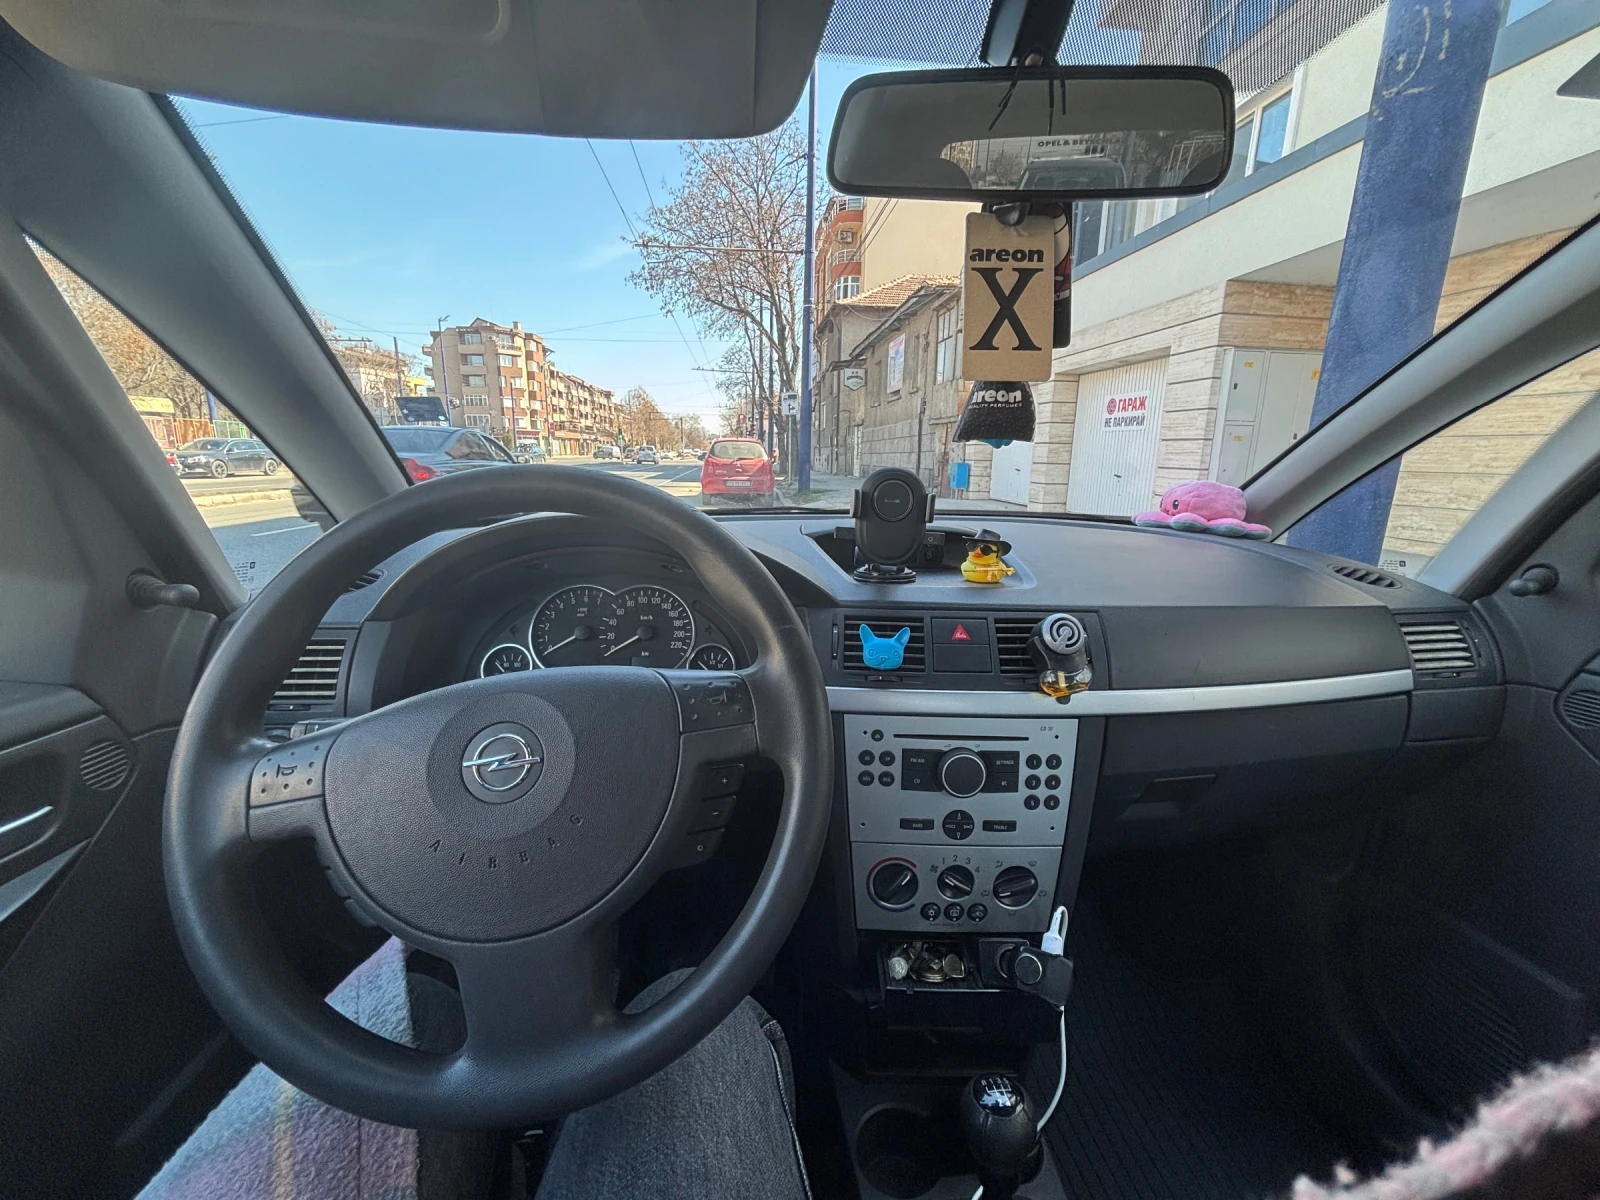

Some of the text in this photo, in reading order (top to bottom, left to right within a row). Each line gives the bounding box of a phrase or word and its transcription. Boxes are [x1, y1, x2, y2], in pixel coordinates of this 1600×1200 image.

[969, 248, 1044, 263] areon
[969, 267, 1044, 351] X
[1117, 396, 1148, 412] ГАРАЖ
[1104, 413, 1146, 428] НЕ ПАРКИРАЙ
